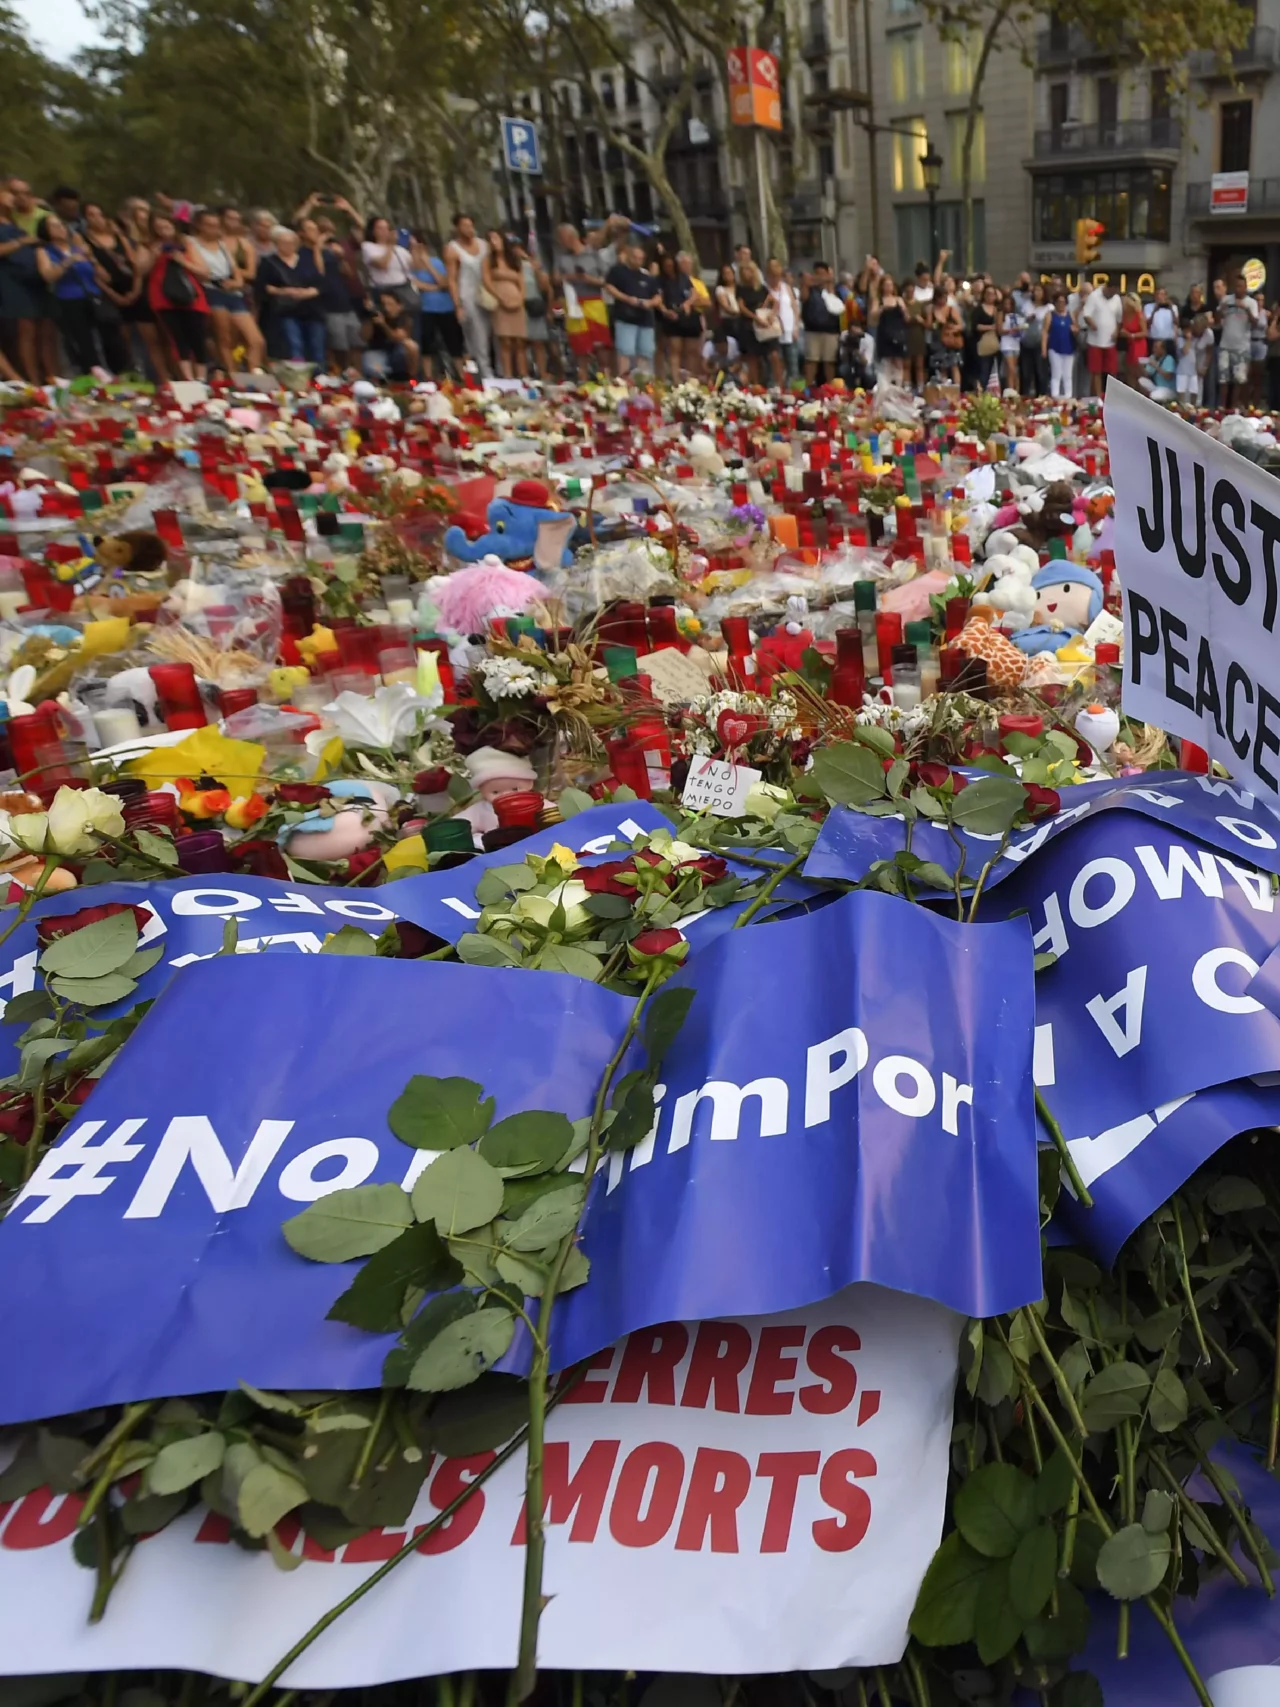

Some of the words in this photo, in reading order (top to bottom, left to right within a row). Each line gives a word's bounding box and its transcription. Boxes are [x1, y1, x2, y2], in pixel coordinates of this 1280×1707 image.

[707, 765, 731, 780] NO
[689, 777, 736, 796] TENGO
[685, 794, 733, 810] MIEDO
[510, 1439, 878, 1555] MORTS
